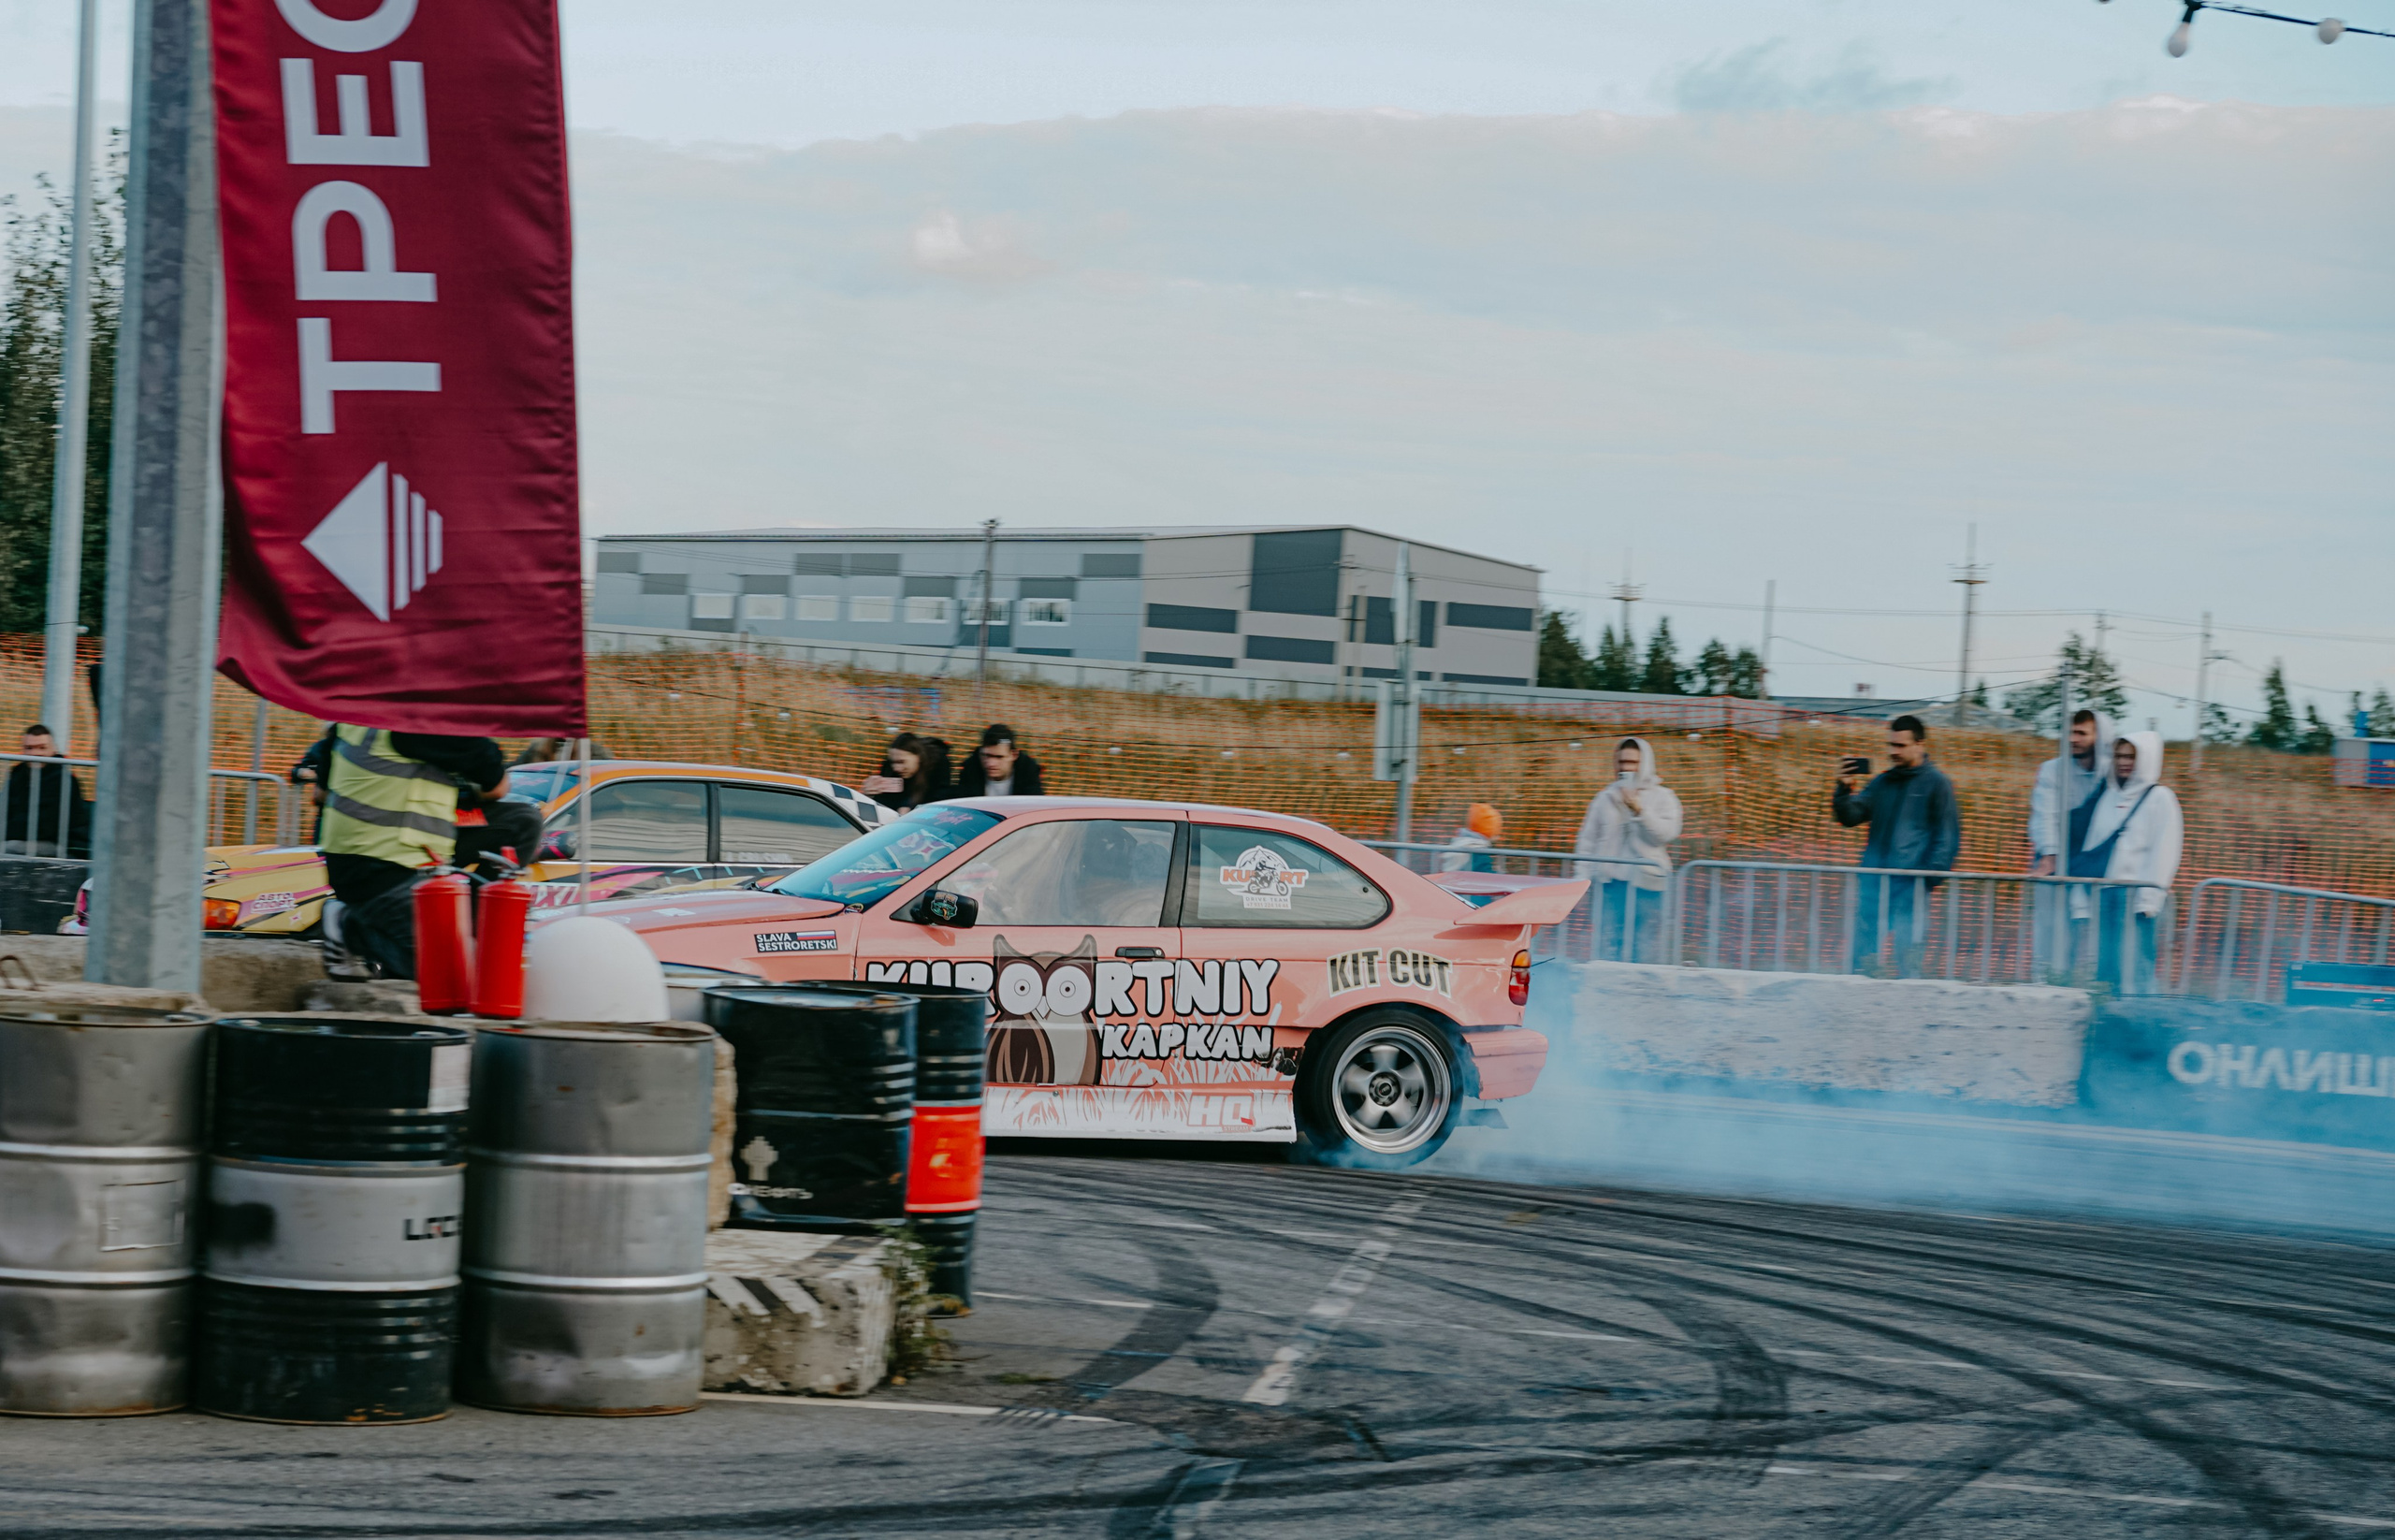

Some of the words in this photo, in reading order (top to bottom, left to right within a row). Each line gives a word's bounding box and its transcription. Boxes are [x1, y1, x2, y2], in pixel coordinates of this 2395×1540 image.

[756, 933, 792, 943] SLAVA
[758, 938, 837, 952] SESTRORETSKI
[1327, 947, 1383, 997] KIT
[1386, 947, 1453, 998] CUT
[1100, 1023, 1274, 1062] KAPKAN
[1187, 1095, 1256, 1126] HQ
